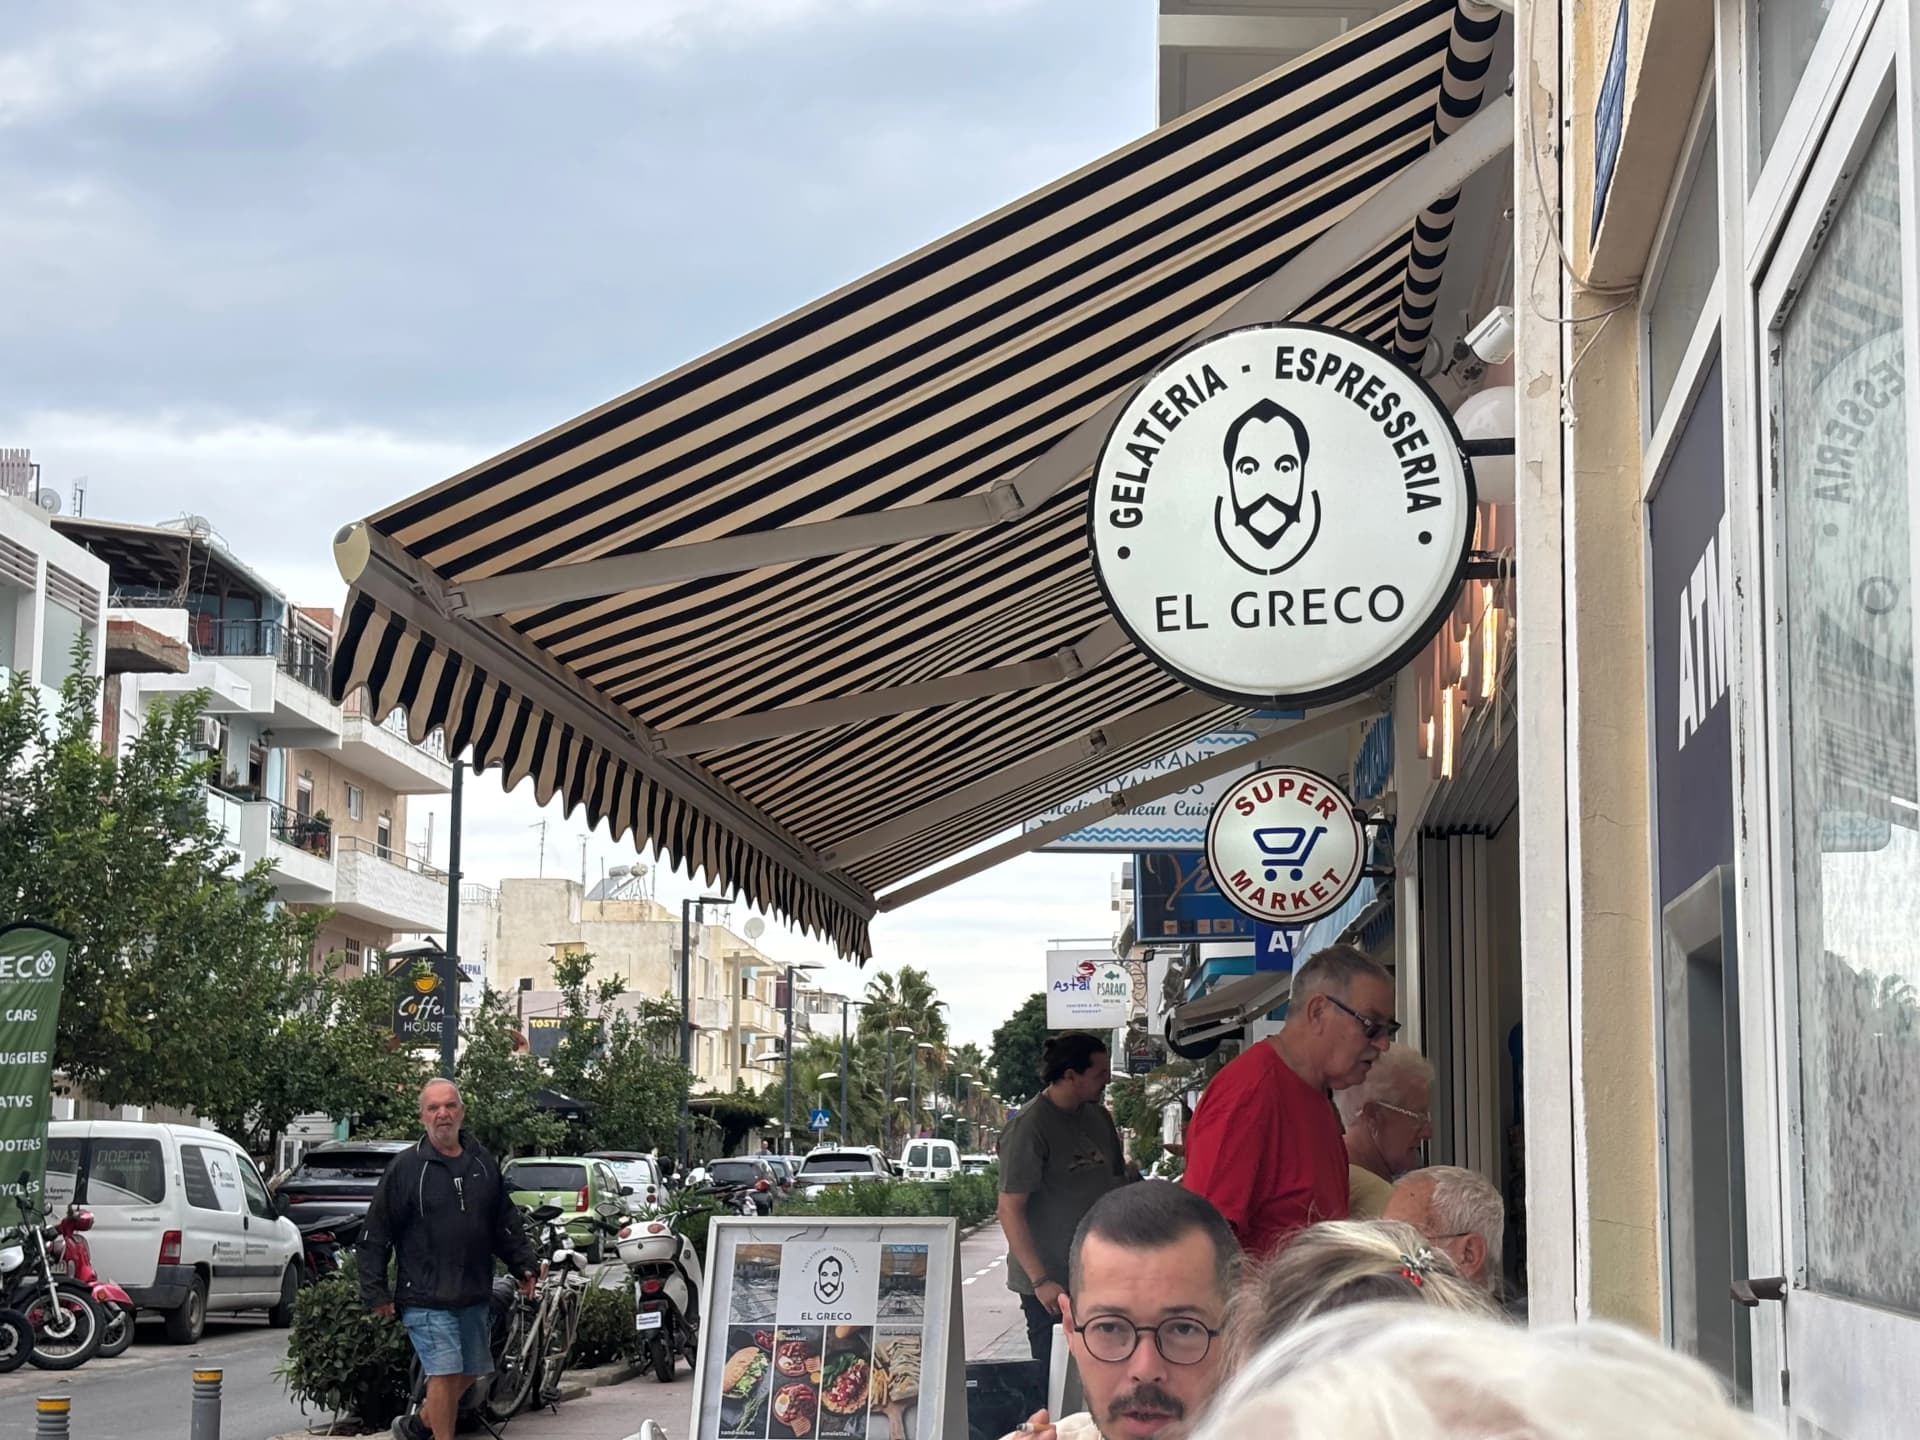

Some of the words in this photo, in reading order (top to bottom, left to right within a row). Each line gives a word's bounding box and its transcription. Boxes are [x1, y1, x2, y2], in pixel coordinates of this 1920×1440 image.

[1110, 363, 1228, 528] GELATERIA
[1275, 346, 1442, 514] ESPRESSERIA
[1155, 594, 1209, 632] EL
[1230, 585, 1404, 629] GRECO
[1679, 512, 1731, 752] ATM
[1235, 778, 1338, 820] SUPER
[1230, 867, 1342, 911] MARKET
[6, 1009, 38, 1022] CARS
[403, 1021, 444, 1033] HOUSE
[801, 1312, 813, 1321] EL
[816, 1312, 853, 1321] GRECO
